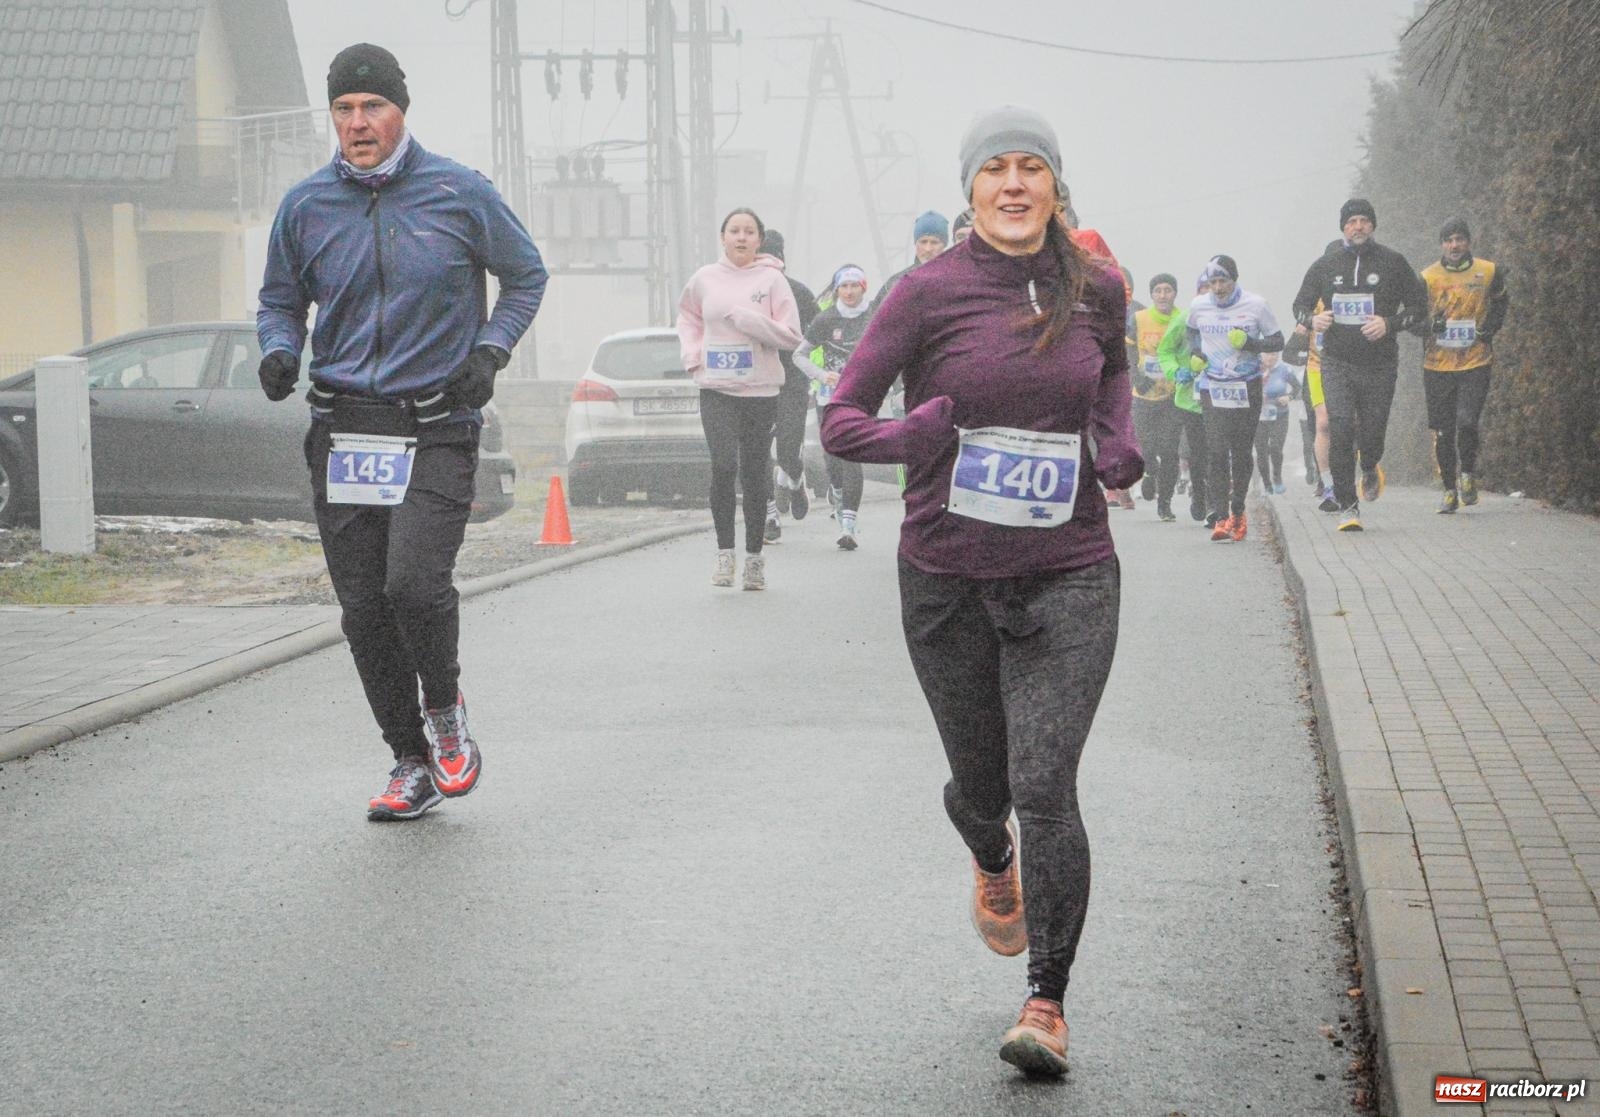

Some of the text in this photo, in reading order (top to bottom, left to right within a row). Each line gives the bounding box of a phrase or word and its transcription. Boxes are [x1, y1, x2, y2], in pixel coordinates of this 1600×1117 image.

[1339, 302, 1366, 315] 131
[717, 352, 740, 368] 39
[342, 453, 395, 483] 145
[978, 453, 1059, 499] 140
